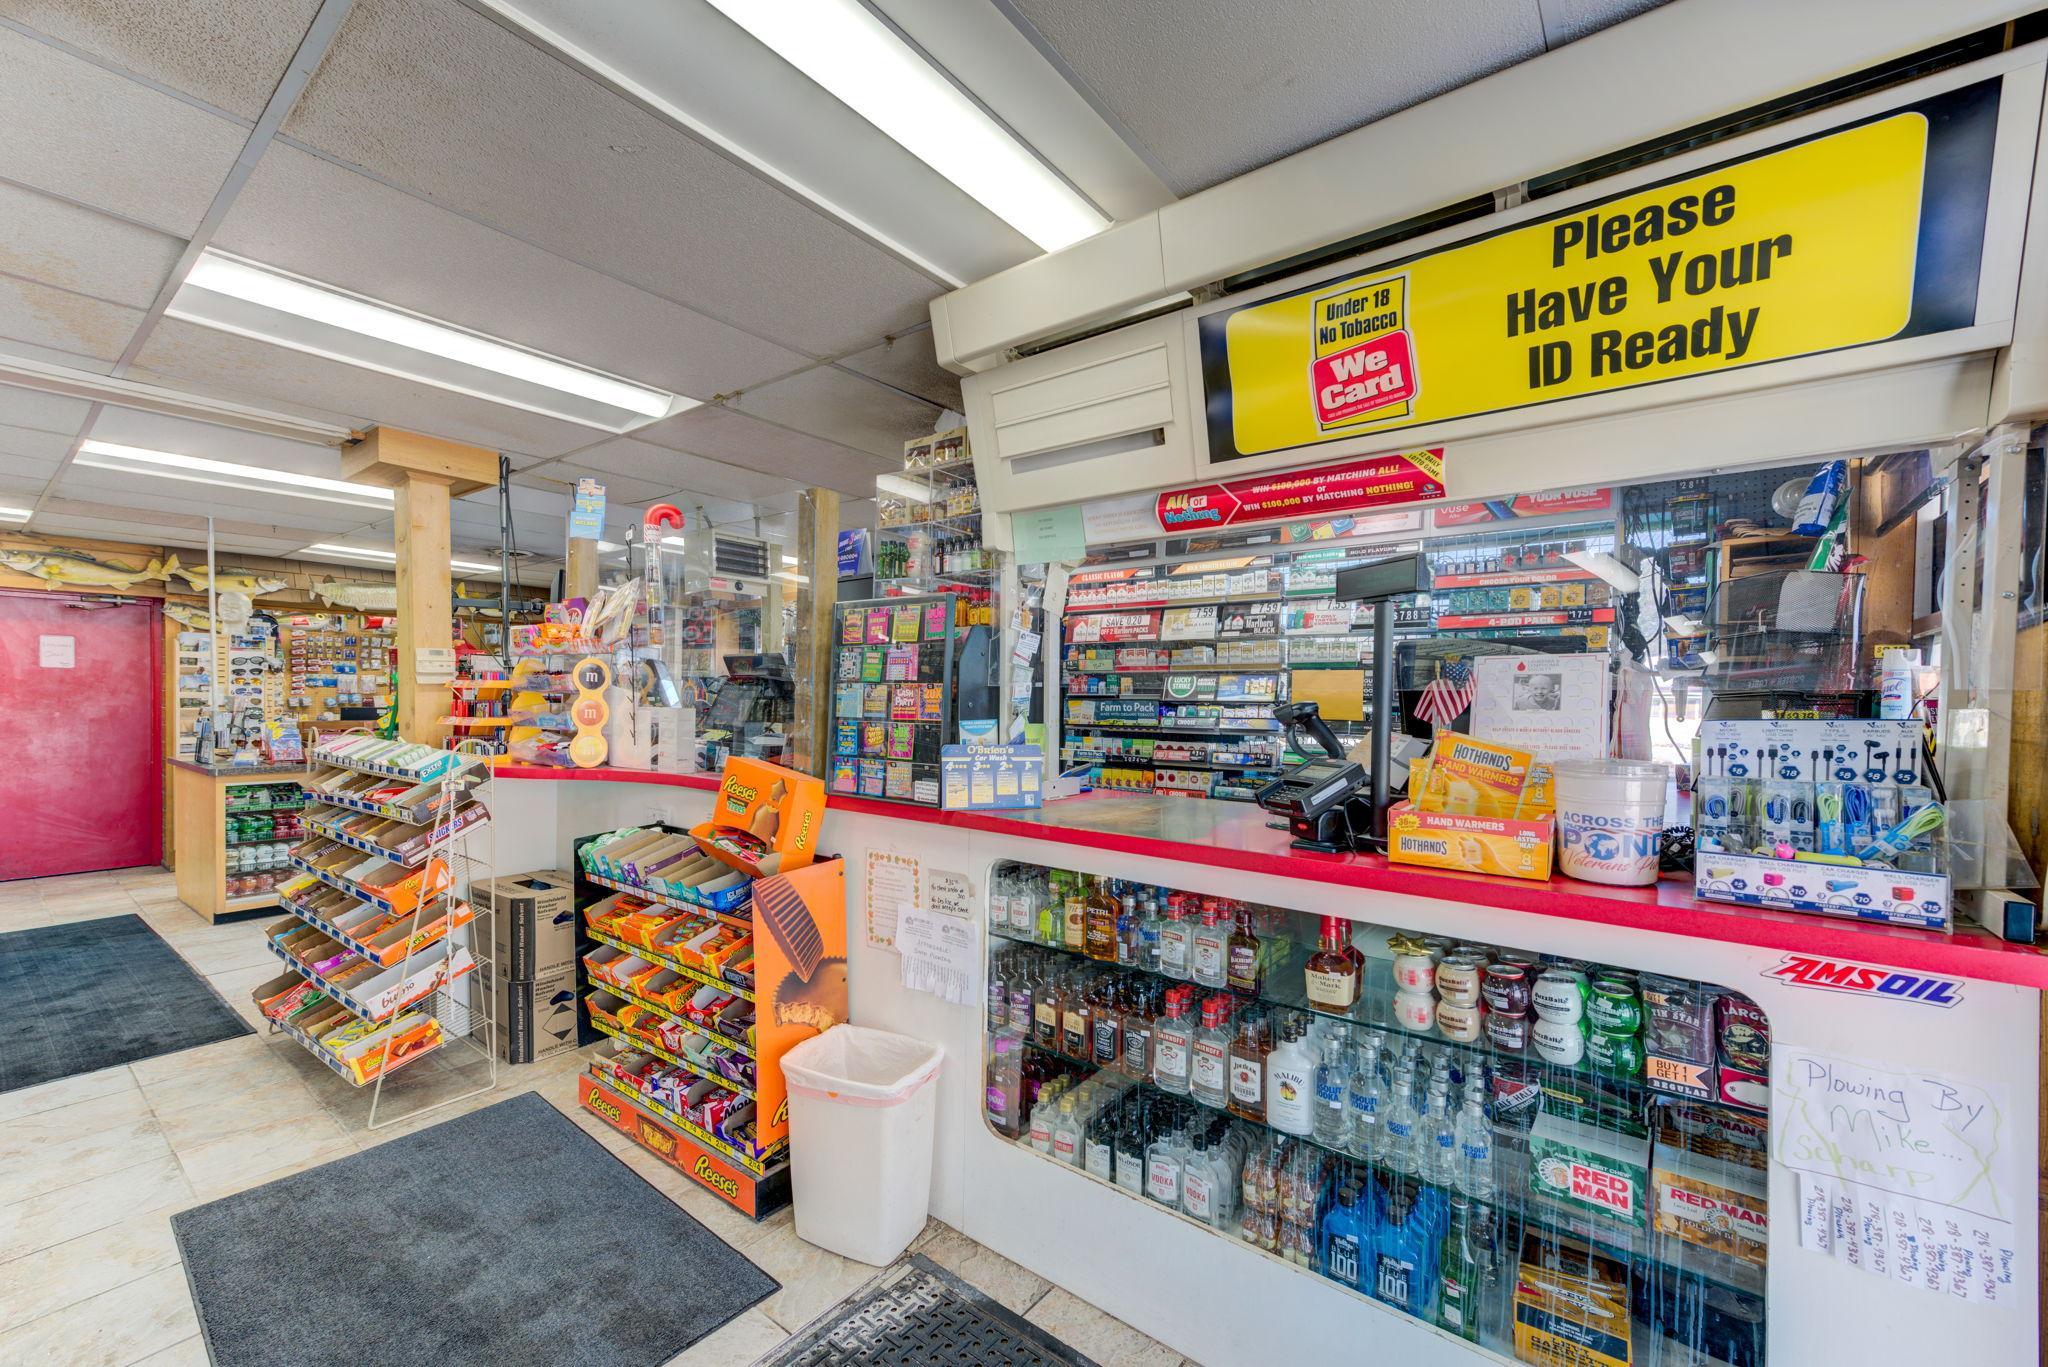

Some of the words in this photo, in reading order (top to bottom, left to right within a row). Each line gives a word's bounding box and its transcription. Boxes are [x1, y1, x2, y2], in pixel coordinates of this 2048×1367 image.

[1552, 183, 1736, 268] Please
[1507, 270, 1628, 338] Have
[1650, 233, 1792, 305] Your
[1327, 296, 1368, 321] Under
[1373, 288, 1390, 308] 18
[1320, 327, 1336, 345] No
[1340, 311, 1397, 340] Tobacco
[1528, 341, 1572, 389] ID
[1591, 304, 1760, 375] Ready
[1330, 350, 1388, 382] We
[1321, 364, 1404, 410] Card
[1408, 454, 1426, 468] LOTTO
[1424, 465, 1440, 478] GAME
[1252, 485, 1270, 494] WIN
[1272, 479, 1311, 490] $100,000
[1312, 475, 1325, 485] BY
[1327, 468, 1376, 483] MATCHING
[1378, 465, 1399, 476] ALL!
[1166, 494, 1189, 510] All
[1243, 503, 1260, 512] WIN
[1262, 497, 1300, 508] $100,000
[1302, 495, 1314, 504] BY
[1316, 489, 1364, 501] MATCHING
[1366, 481, 1414, 495] NOTHING!
[1164, 507, 1221, 523] Nothing
[1082, 572, 1102, 581] CLASSIC
[1480, 578, 1509, 586] CHOOSE
[1510, 576, 1530, 584] YOUR
[1197, 607, 1214, 618] 7.59
[1259, 603, 1278, 613] 7.59
[1106, 617, 1123, 626] SAVE
[1127, 616, 1142, 625] 0.20
[1246, 619, 1274, 628] Marlboro
[1488, 617, 1521, 626] 4-POD
[1524, 616, 1554, 625] PACK
[1254, 627, 1276, 635] BLACK
[586, 672, 598, 682] m
[1172, 682, 1191, 690] STRIKE
[584, 708, 597, 719] m
[1100, 703, 1121, 712] Farm
[1123, 704, 1132, 712] to
[1134, 702, 1154, 712] Pack
[967, 745, 1014, 754] O'Brien's
[1453, 744, 1512, 771] HOTHANDS
[420, 760, 442, 778] Extra
[1468, 766, 1519, 787] WARMERS
[1731, 767, 1743, 775] $8
[1781, 768, 1797, 777] $18
[1839, 770, 1851, 778] $8
[1868, 771, 1880, 780] $8
[1898, 773, 1911, 782] $5
[723, 775, 758, 801] Reese's
[1535, 787, 1544, 798] 8
[727, 801, 746, 814] Trees
[1427, 817, 1453, 826] HAND
[1455, 819, 1505, 831] WARMERS
[1563, 811, 1636, 828] ACROSS
[795, 811, 811, 850] Reese's
[1401, 837, 1447, 855] HOTHANDS
[1513, 835, 1541, 844] LASTING
[1522, 853, 1532, 865] 8
[1562, 848, 1631, 872] Veterans
[1790, 887, 1805, 896] $10
[536, 895, 567, 905] Windshield
[536, 902, 557, 910] Washer
[1854, 895, 1869, 904] $10
[1923, 903, 1940, 913] $15
[535, 976, 565, 988] Windshield
[535, 982, 555, 993] Washer
[1319, 980, 1342, 989] Mark
[1773, 956, 1955, 1004] AMSOIL
[535, 988, 556, 997] Solvent
[1652, 1008, 1668, 1018] TIN
[1673, 1012, 1700, 1027] STAR
[1157, 1031, 1185, 1047] SMIRNOFF
[1193, 1041, 1223, 1058] SMIRNOFF
[1656, 1059, 1679, 1071] BUY
[1273, 1072, 1304, 1087] MALIBU
[1656, 1069, 1679, 1079] GET
[1513, 1087, 1534, 1102] HALF
[1653, 1080, 1708, 1098] REGULAR
[1798, 1059, 1910, 1123] Plowing
[1922, 1079, 1984, 1131] By
[588, 1088, 621, 1122] Reese's
[1678, 1107, 1713, 1124] RED
[1717, 1120, 1756, 1136] MAN
[1461, 1143, 1489, 1154] ABSOLUT
[1464, 1150, 1487, 1160] VODKA
[694, 1155, 738, 1198] Reese's
[1590, 1163, 1608, 1173] BEST
[1609, 1166, 1632, 1178] CHEW
[1151, 1172, 1173, 1187] VODKA
[1572, 1165, 1629, 1193] RED
[1185, 1186, 1206, 1203] VODKA
[1572, 1181, 1629, 1209] MAN
[1670, 1188, 1717, 1209] RED
[1721, 1203, 1767, 1227] MAN
[1681, 1218, 1721, 1237] GOLDEN
[1331, 1245, 1357, 1262] BLUE
[1330, 1251, 1357, 1283] 100
[1378, 1264, 1408, 1282] BLUE
[1378, 1273, 1408, 1302] 100
